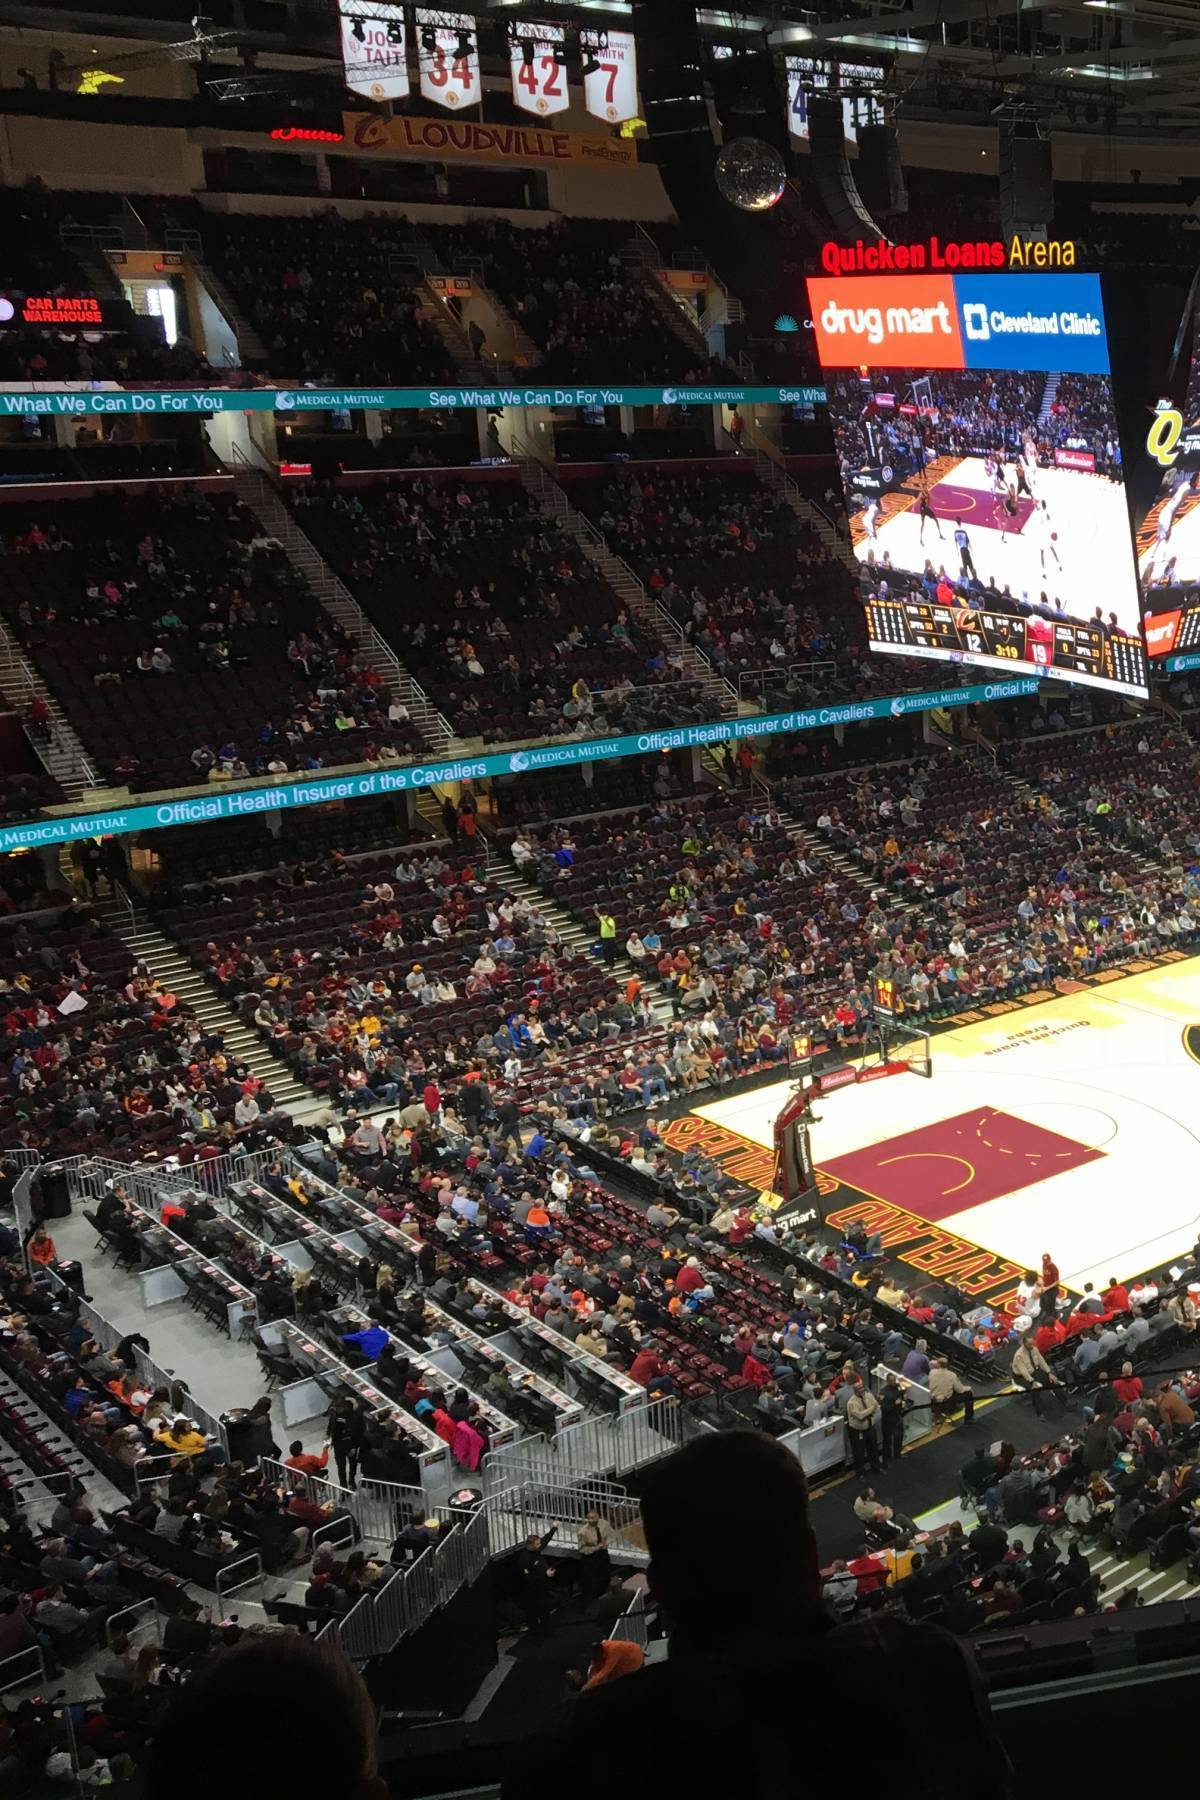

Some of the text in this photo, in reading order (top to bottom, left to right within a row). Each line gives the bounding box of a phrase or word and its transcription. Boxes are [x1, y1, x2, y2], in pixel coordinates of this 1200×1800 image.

[428, 45, 474, 89] 34
[518, 56, 562, 96] 42
[600, 64, 618, 103] 7
[402, 119, 572, 160] LOUDVILLE
[822, 235, 1075, 276] Quicken Loans Arena
[26, 298, 98, 310] CAR PARTS
[22, 310, 102, 322] WAREHOUSE
[821, 300, 954, 345] drug mart
[990, 311, 1101, 336] Cleveland Clinic
[6, 395, 223, 412] What We Can Do For You
[296, 395, 342, 405] MEDICAL
[429, 390, 623, 406] See What We Can Do For You
[678, 391, 715, 401] MEDICAL
[778, 389, 800, 402] See
[1157, 400, 1172, 410] The
[1147, 409, 1183, 465] Q
[942, 624, 948, 634] 2
[966, 634, 981, 652] 12
[995, 644, 1018, 658] 3:19
[1031, 644, 1046, 663] 19
[985, 683, 1020, 699] Official
[907, 696, 939, 709] MEDICAL
[637, 705, 875, 751] Official Health Insurer of the Cavaliers
[531, 750, 576, 765] MEDICAL
[156, 762, 487, 824] Official Health Insurer of the Cavaliers
[4, 825, 68, 846] MEDICAL
[983, 1020, 1091, 1056] Quicken Loans
[1006, 1024, 1049, 1041] Arena
[789, 1208, 817, 1228] mart
